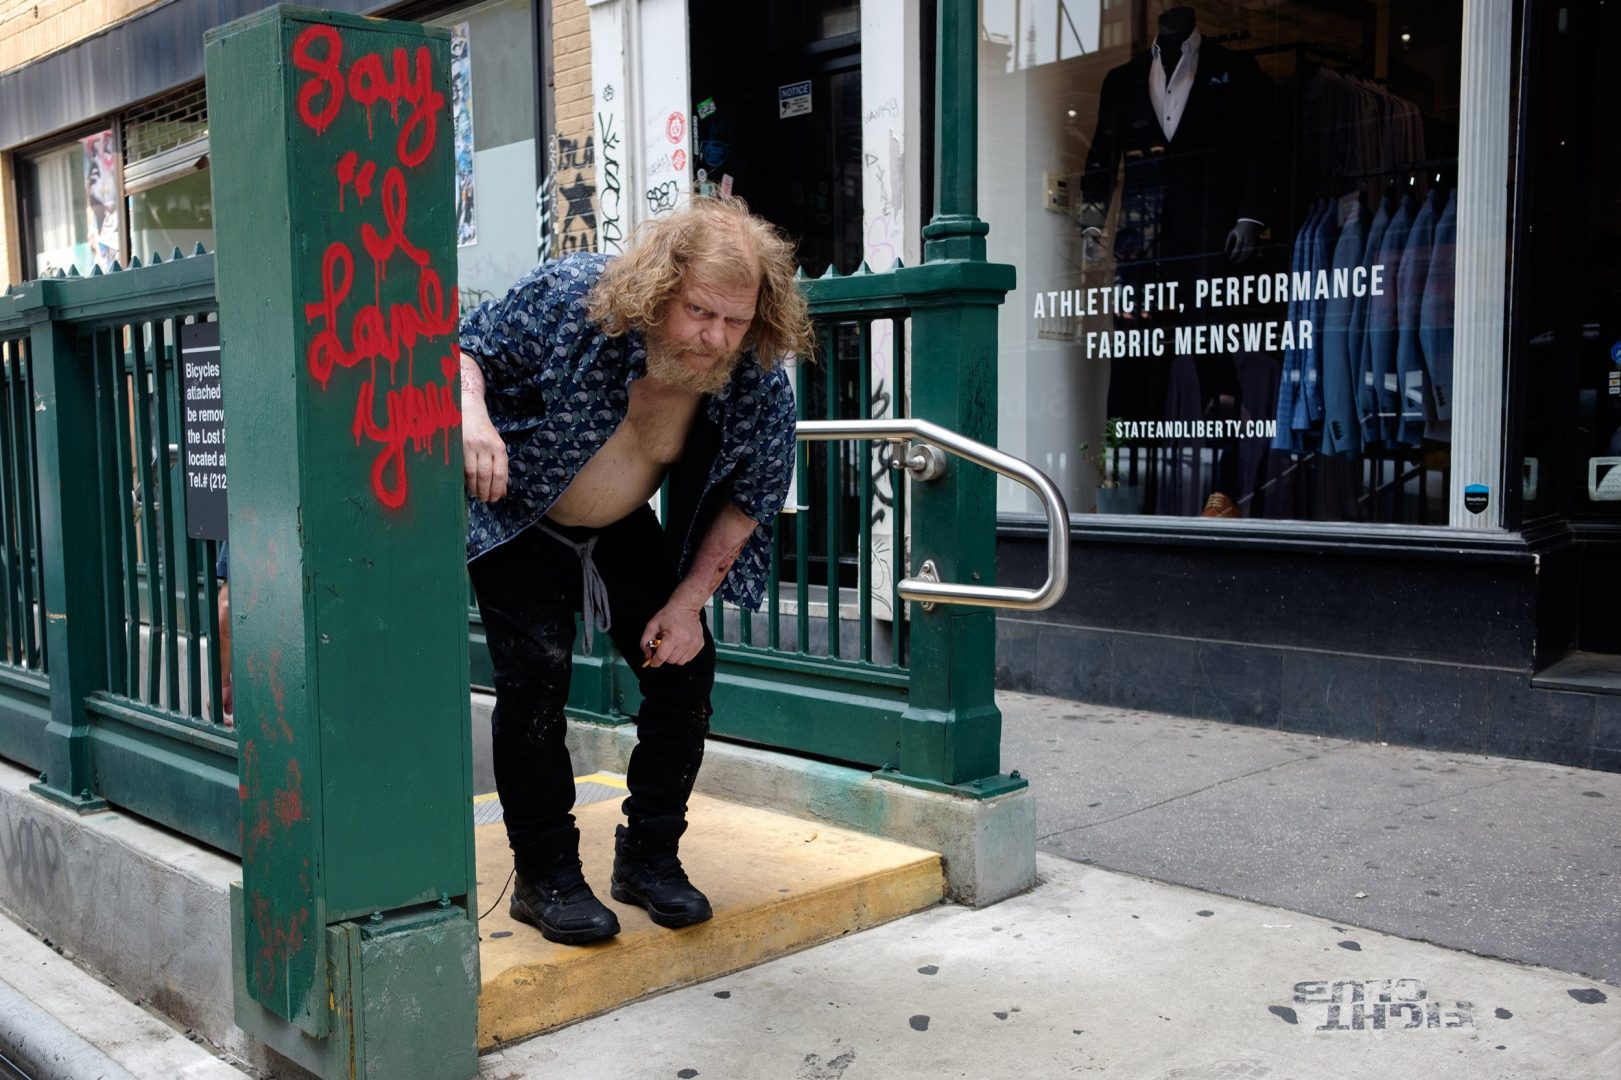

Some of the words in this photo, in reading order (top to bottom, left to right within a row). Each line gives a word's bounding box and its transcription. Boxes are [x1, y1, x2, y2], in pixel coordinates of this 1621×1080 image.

[292, 23, 446, 167] Say
[781, 84, 809, 98] NOTICE
[1033, 284, 1134, 319] ATHLETIC
[1144, 281, 1185, 313] FIT,
[1195, 264, 1385, 309] PERFORMANCE
[1086, 327, 1165, 359] FABRIC
[1174, 319, 1313, 356] MENSWEAR
[185, 362, 220, 382] Bicycles
[186, 384, 221, 401] attached
[187, 406, 197, 422] be
[187, 428, 201, 444] the
[202, 428, 221, 444] Lost
[1114, 418, 1277, 440] STATEANDLIBERTY.COM
[188, 450, 218, 466] located
[188, 472, 208, 488] Tel.#
[209, 472, 227, 492] (212
[1293, 978, 1428, 1004] CLUB
[1315, 1001, 1475, 1031] FIGHT
